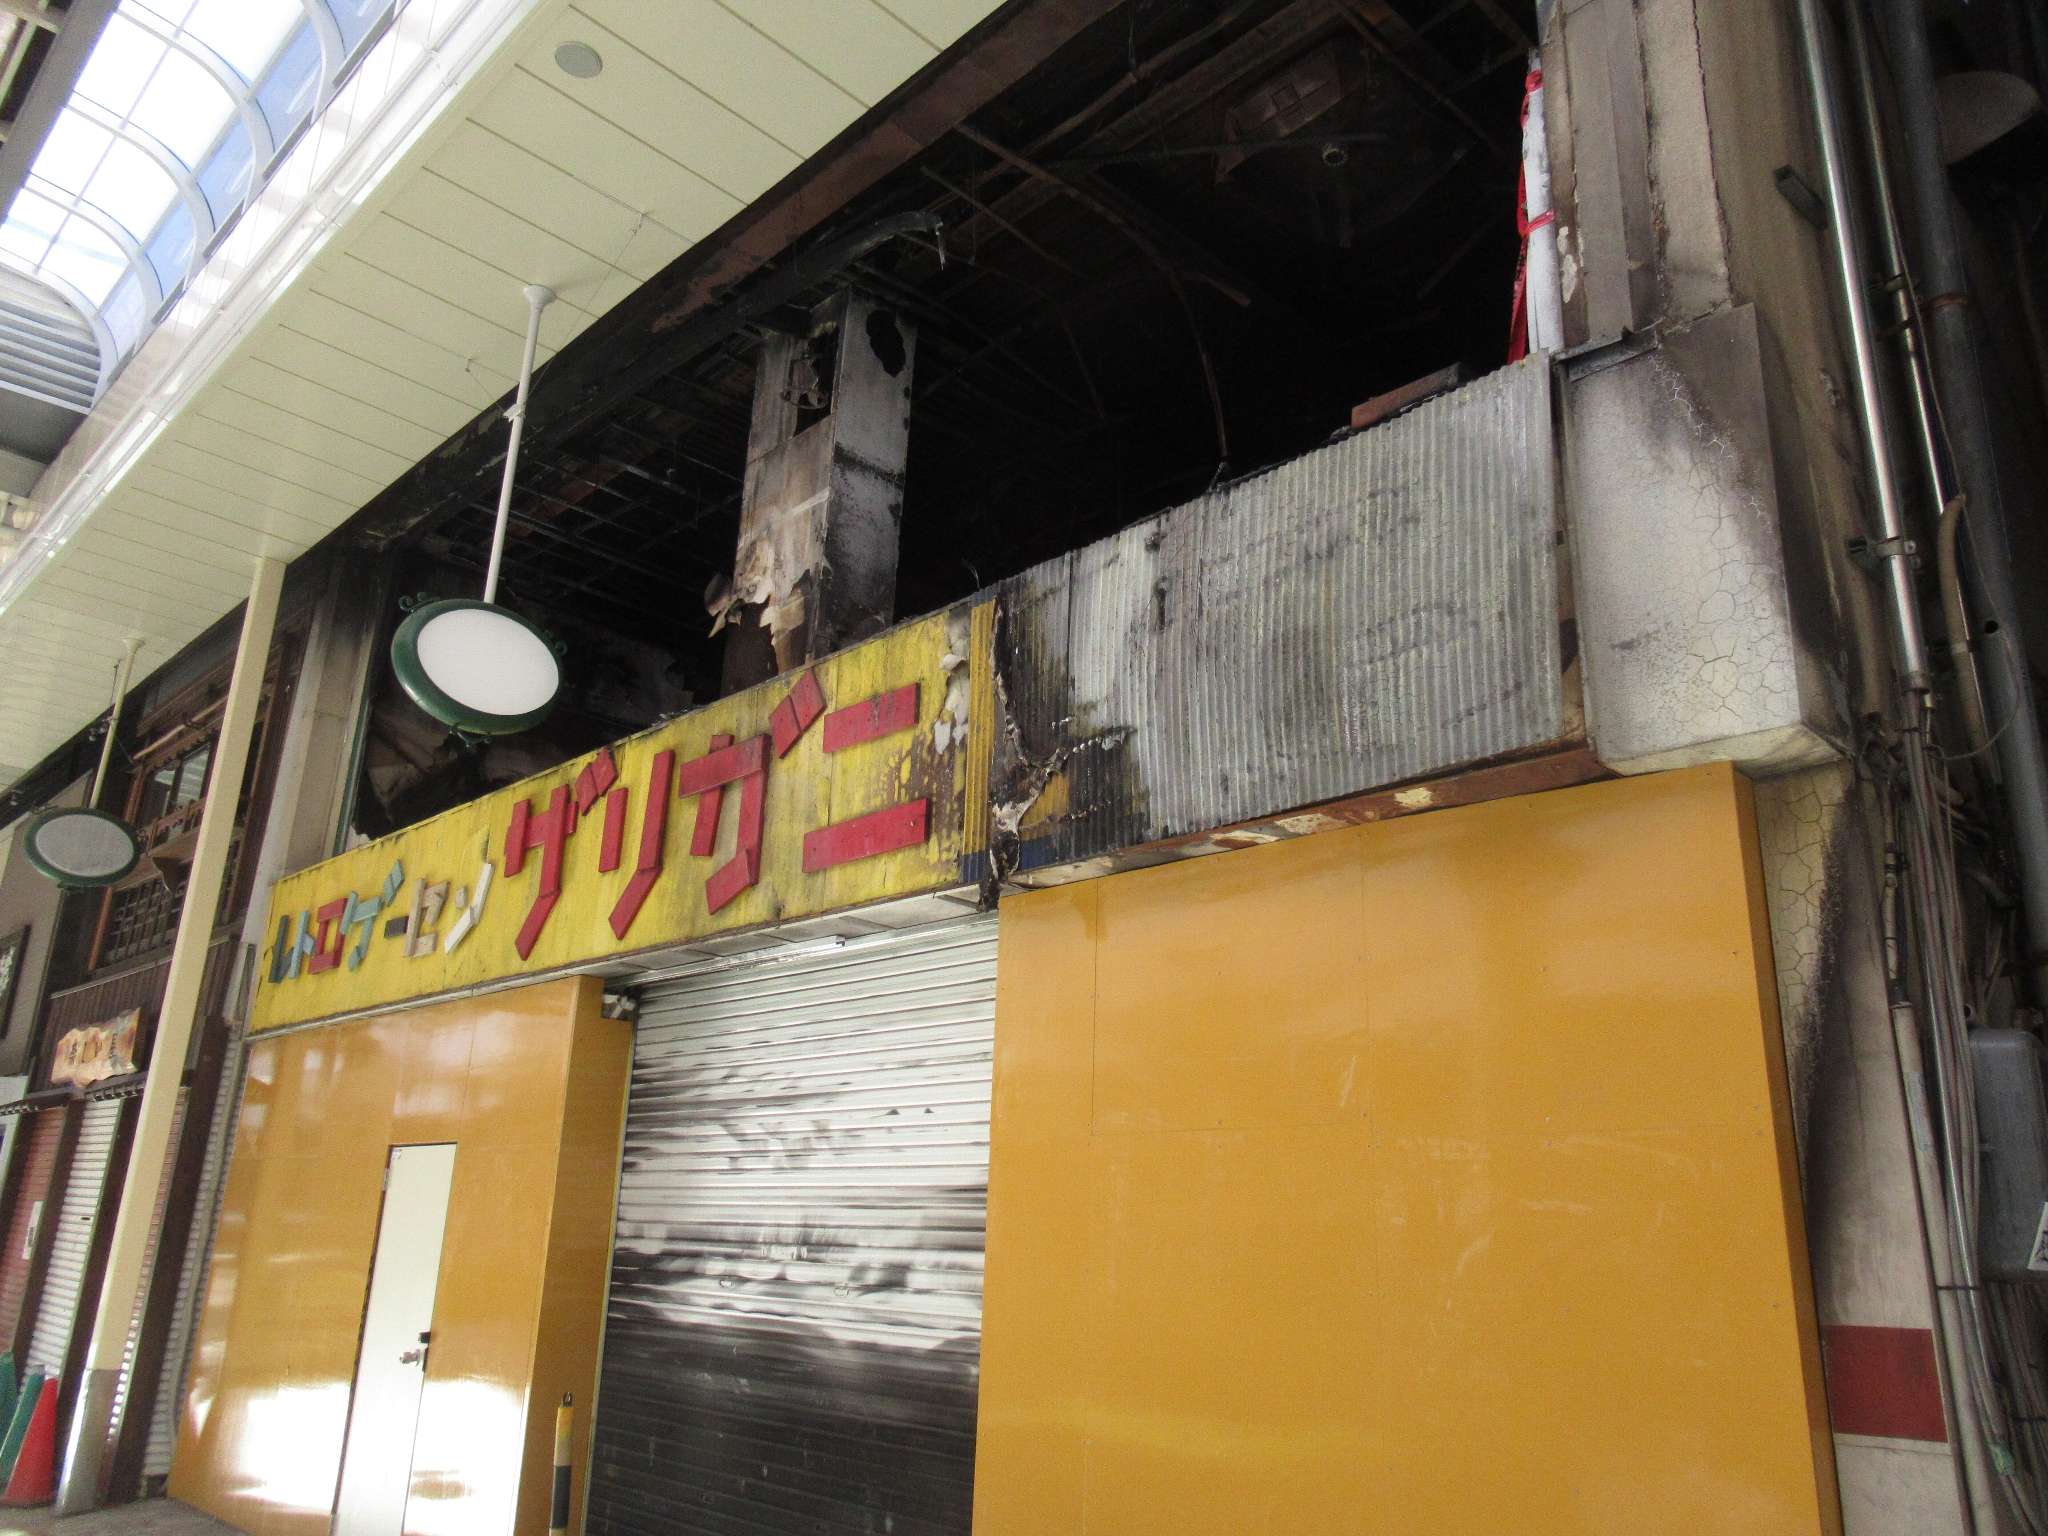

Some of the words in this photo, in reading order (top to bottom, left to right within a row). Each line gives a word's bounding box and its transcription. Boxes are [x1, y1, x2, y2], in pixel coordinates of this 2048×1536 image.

[268, 859, 492, 984] レトロゲーセン
[503, 669, 929, 961] ザリガニ
